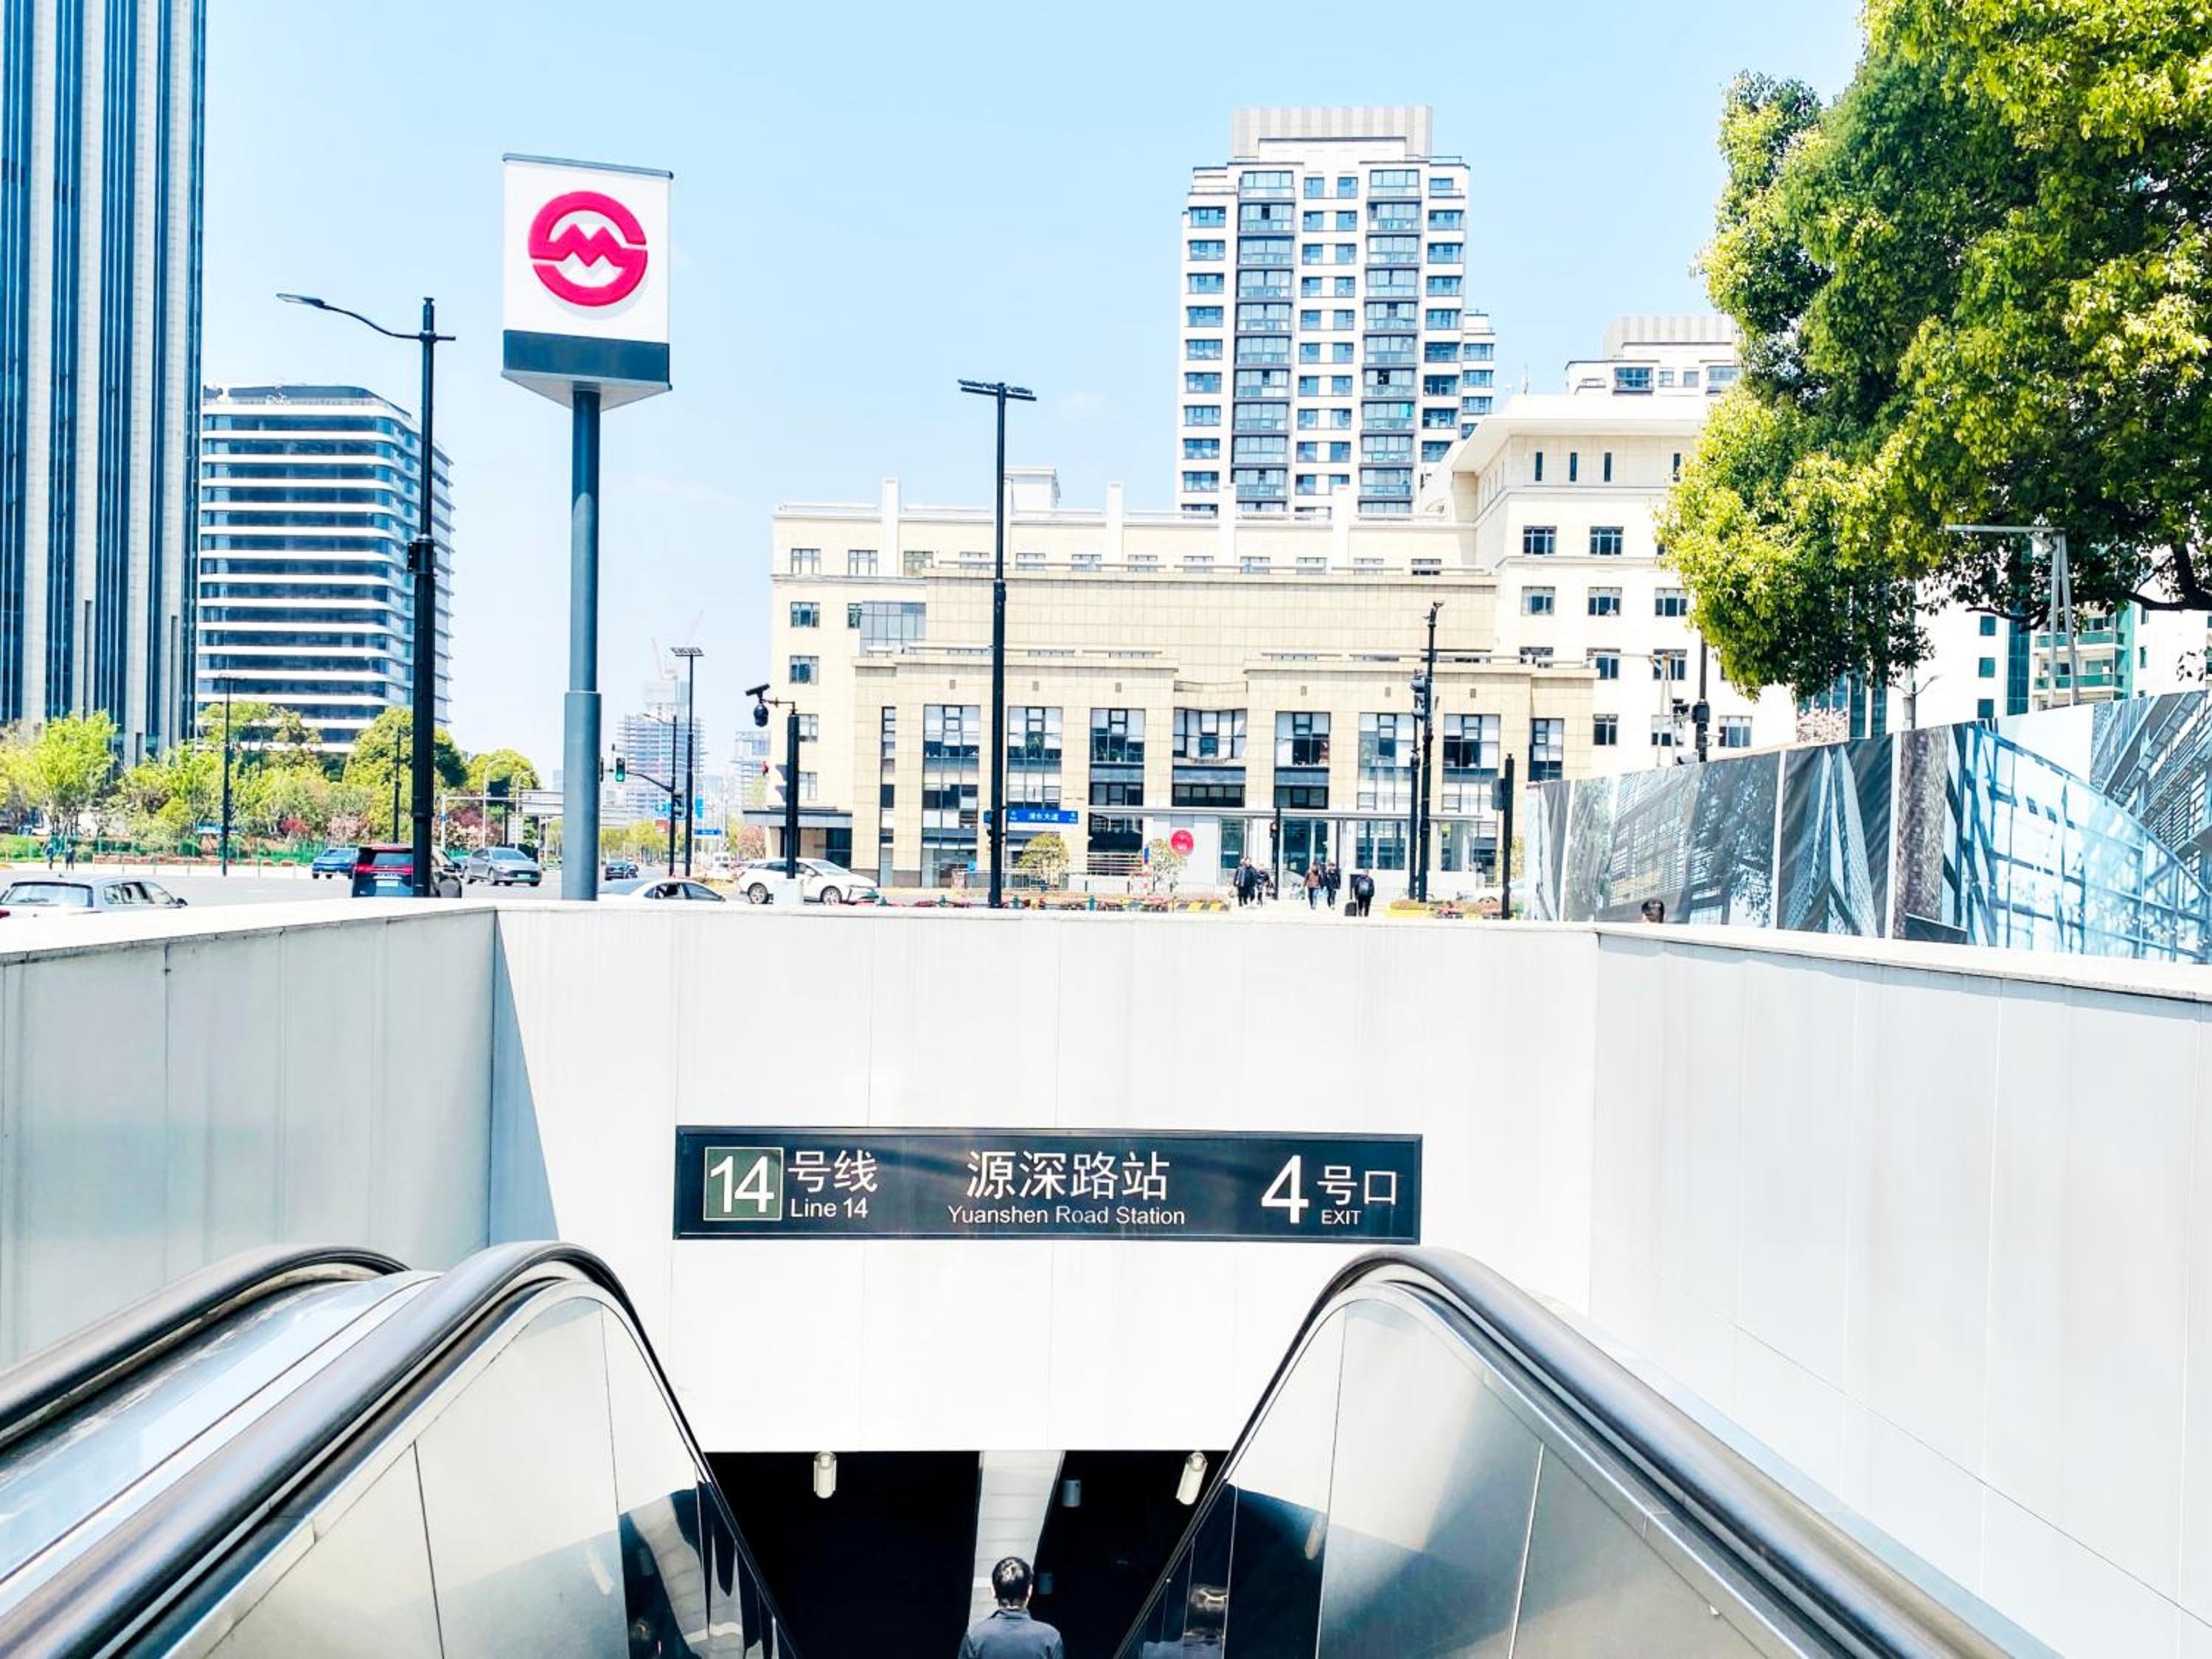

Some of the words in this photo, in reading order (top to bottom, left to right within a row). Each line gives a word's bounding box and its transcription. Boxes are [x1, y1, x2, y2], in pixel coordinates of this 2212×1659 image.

[710, 1155, 775, 1213] 14
[787, 1150, 878, 1193] 号线
[965, 1150, 1170, 1200] 源深路站
[1261, 1155, 1309, 1224] 4
[1317, 1166, 1397, 1206] 号口
[790, 1198, 837, 1218] Line
[843, 1197, 869, 1219] 14
[947, 1205, 1048, 1223] Yuanshen
[1056, 1206, 1109, 1223] Road
[1116, 1206, 1185, 1225] Station
[1321, 1210, 1361, 1225] EXIT
